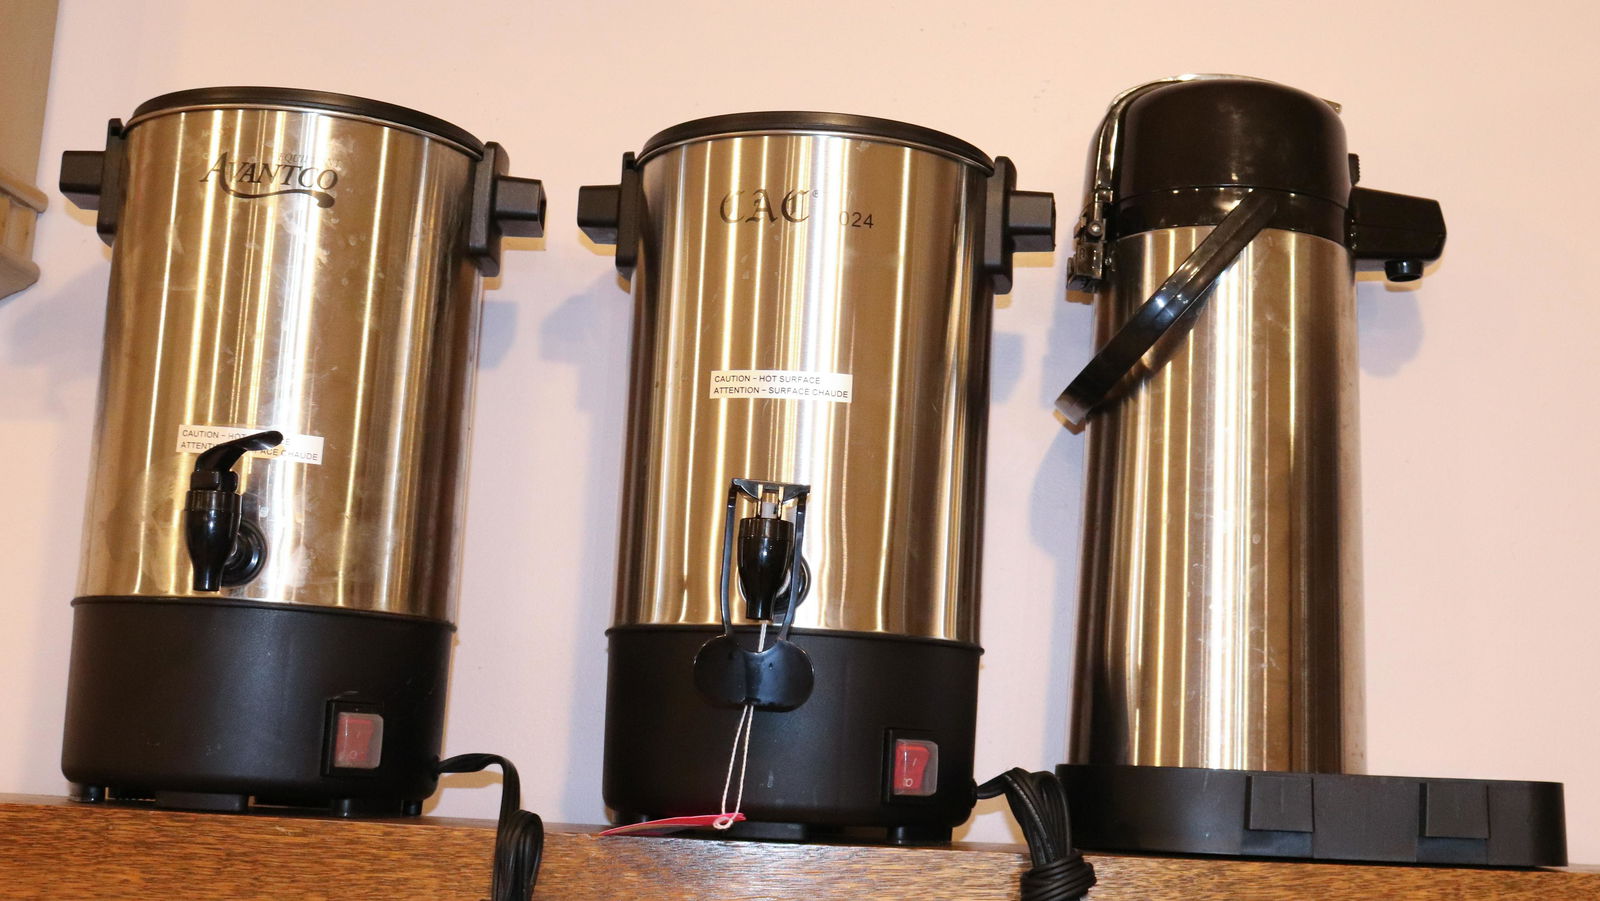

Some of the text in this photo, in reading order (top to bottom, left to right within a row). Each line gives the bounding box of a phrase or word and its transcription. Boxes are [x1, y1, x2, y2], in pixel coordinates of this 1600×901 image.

[198, 151, 339, 208] AVANTCO
[839, 211, 874, 229] 024
[714, 375, 751, 383] CAUTION
[759, 375, 777, 383] HOT
[779, 376, 821, 385] SURFACE
[713, 386, 760, 394] ATTENTION
[768, 387, 809, 396] SURFACE
[813, 388, 849, 398] CHAUDE
[182, 429, 220, 439] CAUTION
